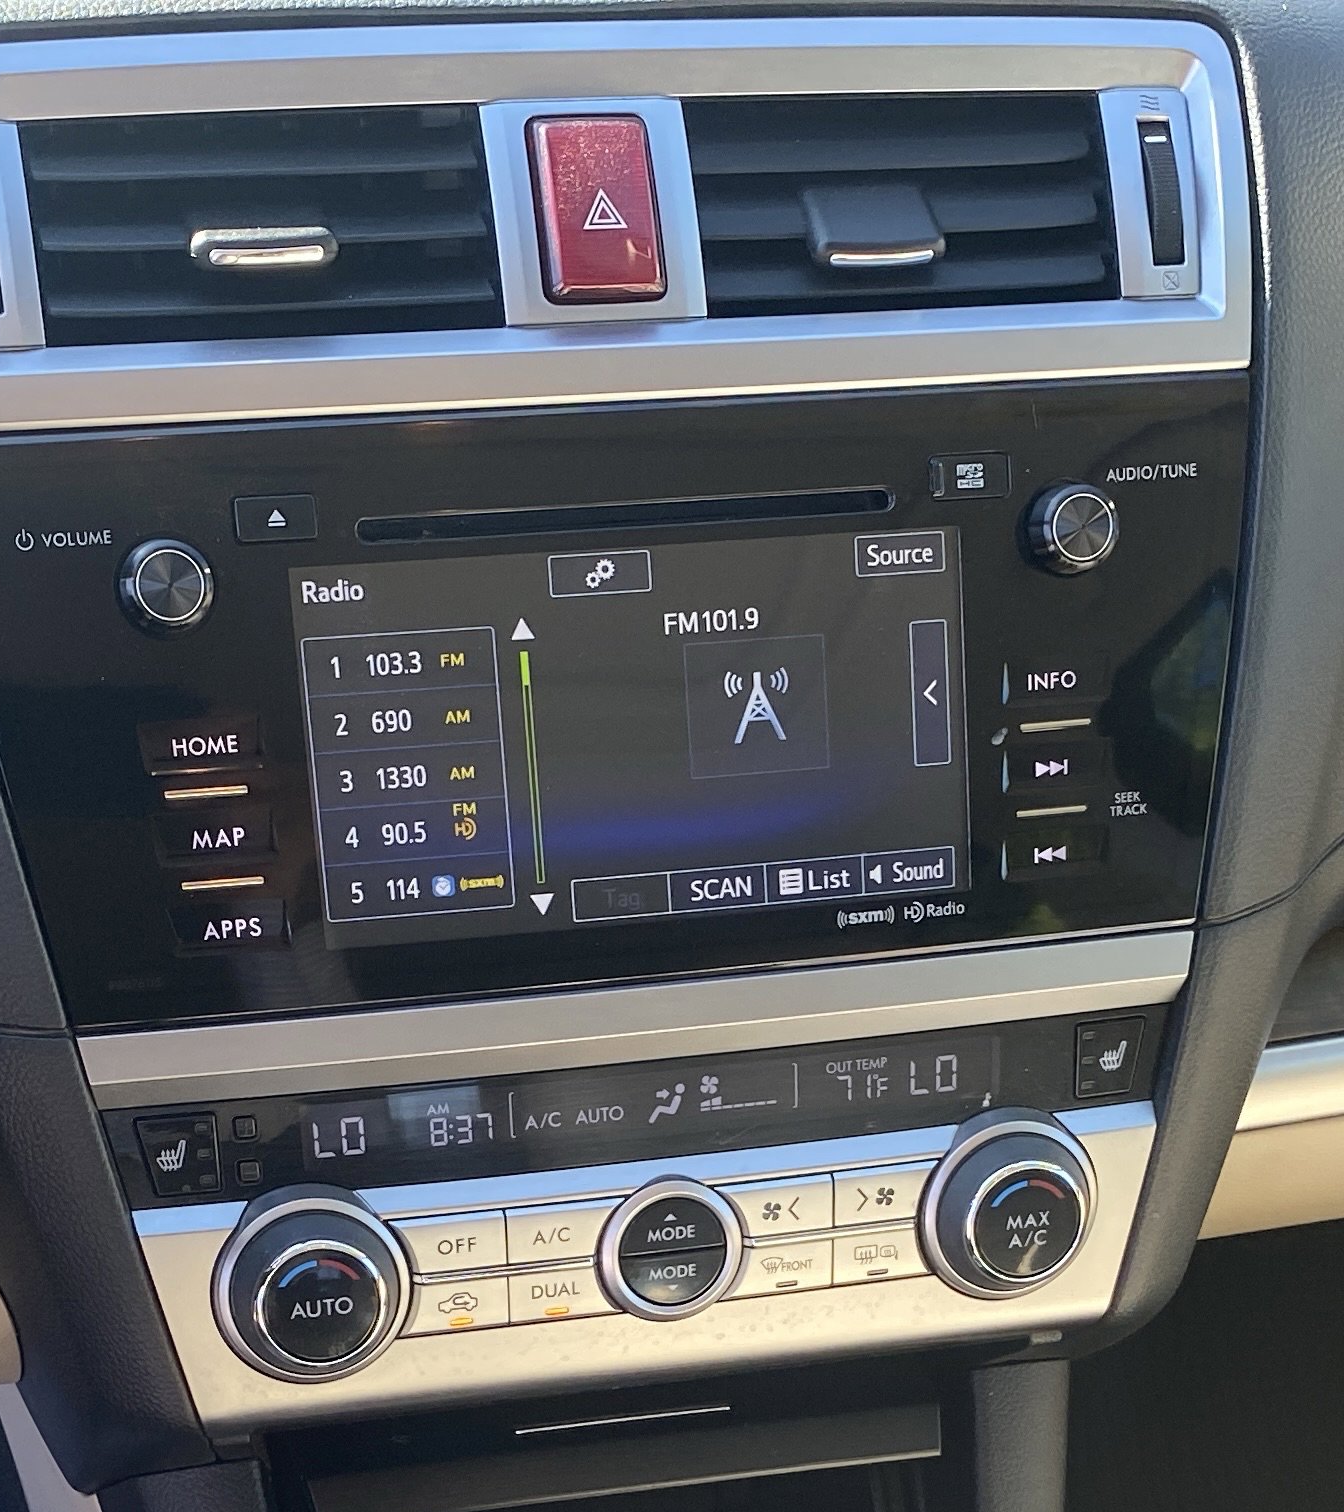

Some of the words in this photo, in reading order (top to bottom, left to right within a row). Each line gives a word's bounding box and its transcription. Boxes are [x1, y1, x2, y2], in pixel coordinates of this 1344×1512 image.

[1106, 462, 1198, 483] AUDIO/TUNE
[41, 529, 112, 548] VOLUME
[867, 544, 934, 567] Source
[301, 579, 365, 604] Radio
[330, 657, 342, 679] 1
[365, 651, 423, 677] 103.3
[440, 653, 465, 668] FM
[1027, 671, 1077, 691] INFO
[334, 713, 349, 737] 2
[371, 709, 412, 734] 690
[445, 709, 471, 724] AM
[172, 735, 238, 757] HOME
[339, 770, 354, 793] 3
[375, 765, 427, 790] 1330
[449, 765, 475, 780] AM
[1114, 791, 1141, 804] SEEK
[1109, 803, 1148, 817] TRACK
[345, 826, 359, 849] 4
[381, 821, 427, 846] 90.5
[452, 802, 477, 817] FM
[192, 827, 245, 850] MAP
[808, 869, 850, 891] List
[892, 858, 944, 883] Sound
[351, 882, 364, 904] 5
[386, 877, 420, 901] 114
[690, 876, 753, 902] SCAN
[203, 919, 263, 941] APPS
[826, 1061, 852, 1074] OUT
[856, 1057, 887, 1070] TEMP
[427, 1103, 449, 1116] AM
[525, 1111, 561, 1130] A/C
[576, 1105, 624, 1125] AUTO
[430, 1112, 493, 1147] 8:37
[1006, 1210, 1051, 1232] MAX
[532, 1227, 571, 1246] A/C
[647, 1224, 696, 1243] MODE
[1007, 1229, 1047, 1248] A/C
[438, 1237, 477, 1255] OFF
[648, 1263, 697, 1282] MODE
[781, 1258, 813, 1273] FRONT
[531, 1282, 581, 1300] DUAL
[290, 1297, 354, 1320] AUTO
